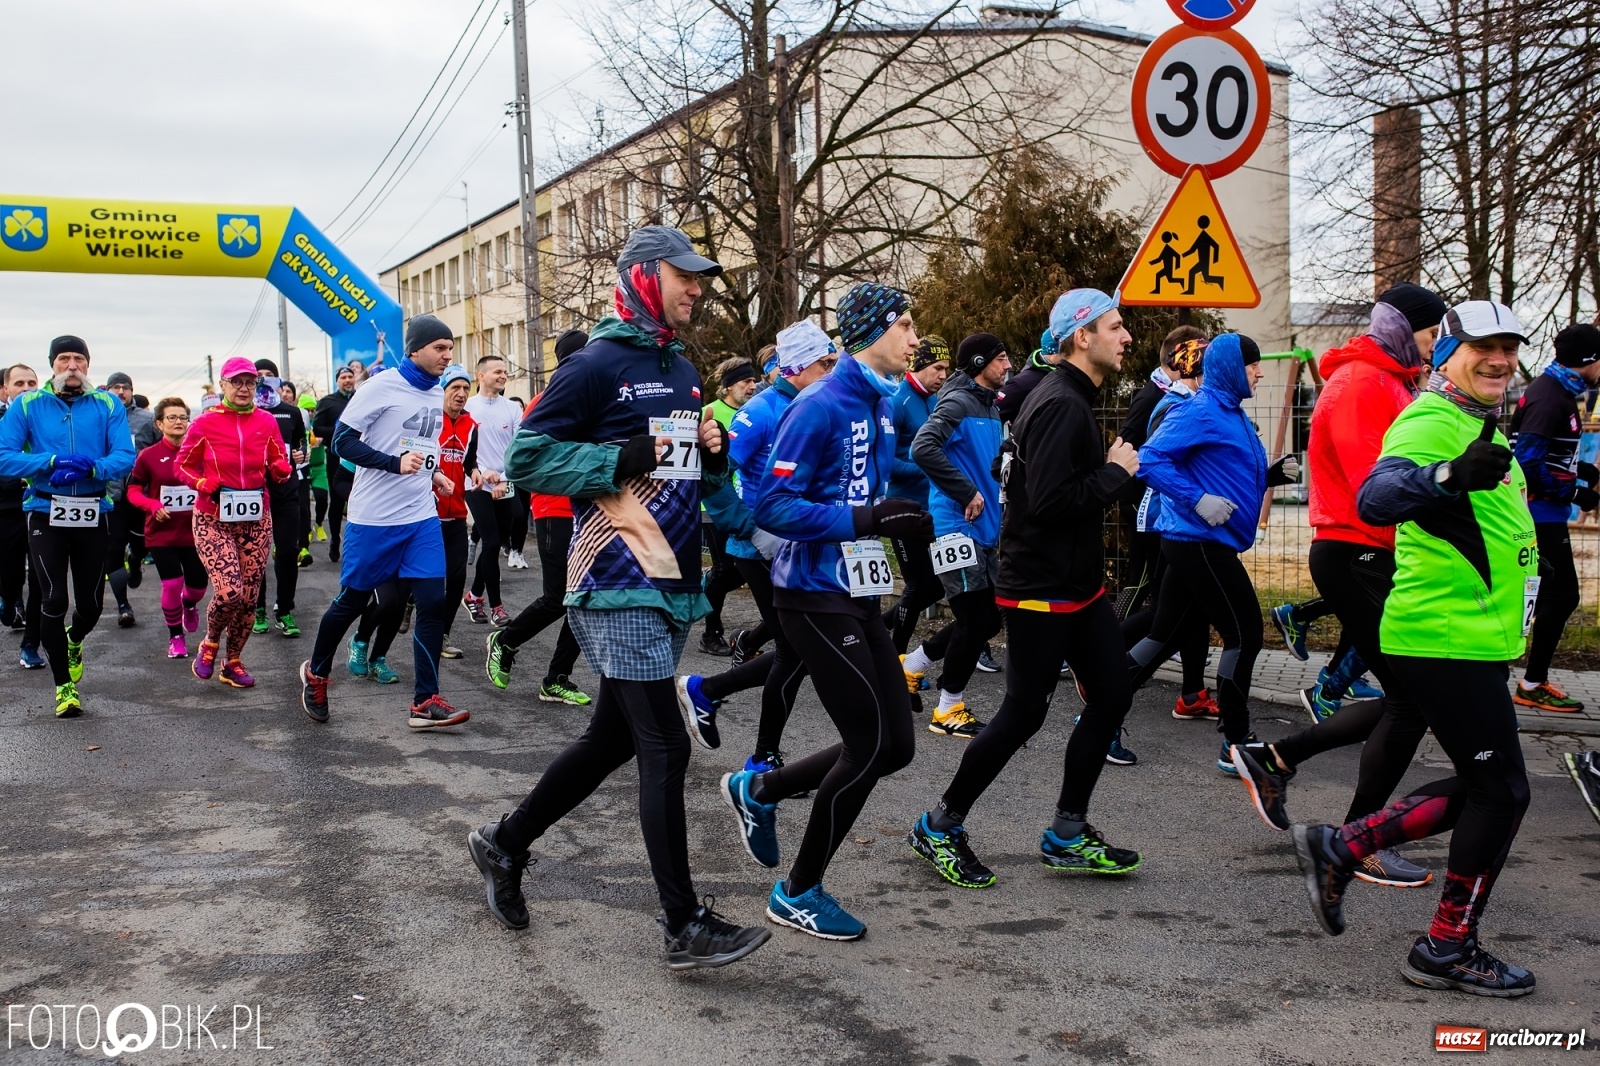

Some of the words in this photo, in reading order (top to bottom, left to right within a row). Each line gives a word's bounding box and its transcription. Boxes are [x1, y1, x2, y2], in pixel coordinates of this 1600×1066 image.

[1156, 61, 1249, 140] 30
[90, 208, 177, 223] Gmina
[67, 223, 201, 242] Pietrowice
[85, 242, 184, 260] Wielkie
[293, 232, 340, 279] Gmina
[336, 272, 378, 312] ludzi
[280, 250, 360, 324] aktywnych
[635, 387, 674, 396] MARATHON
[163, 494, 196, 507] 212
[223, 502, 260, 516] 109
[53, 506, 96, 522] 239
[934, 544, 972, 567] 189
[852, 560, 891, 586] 183
